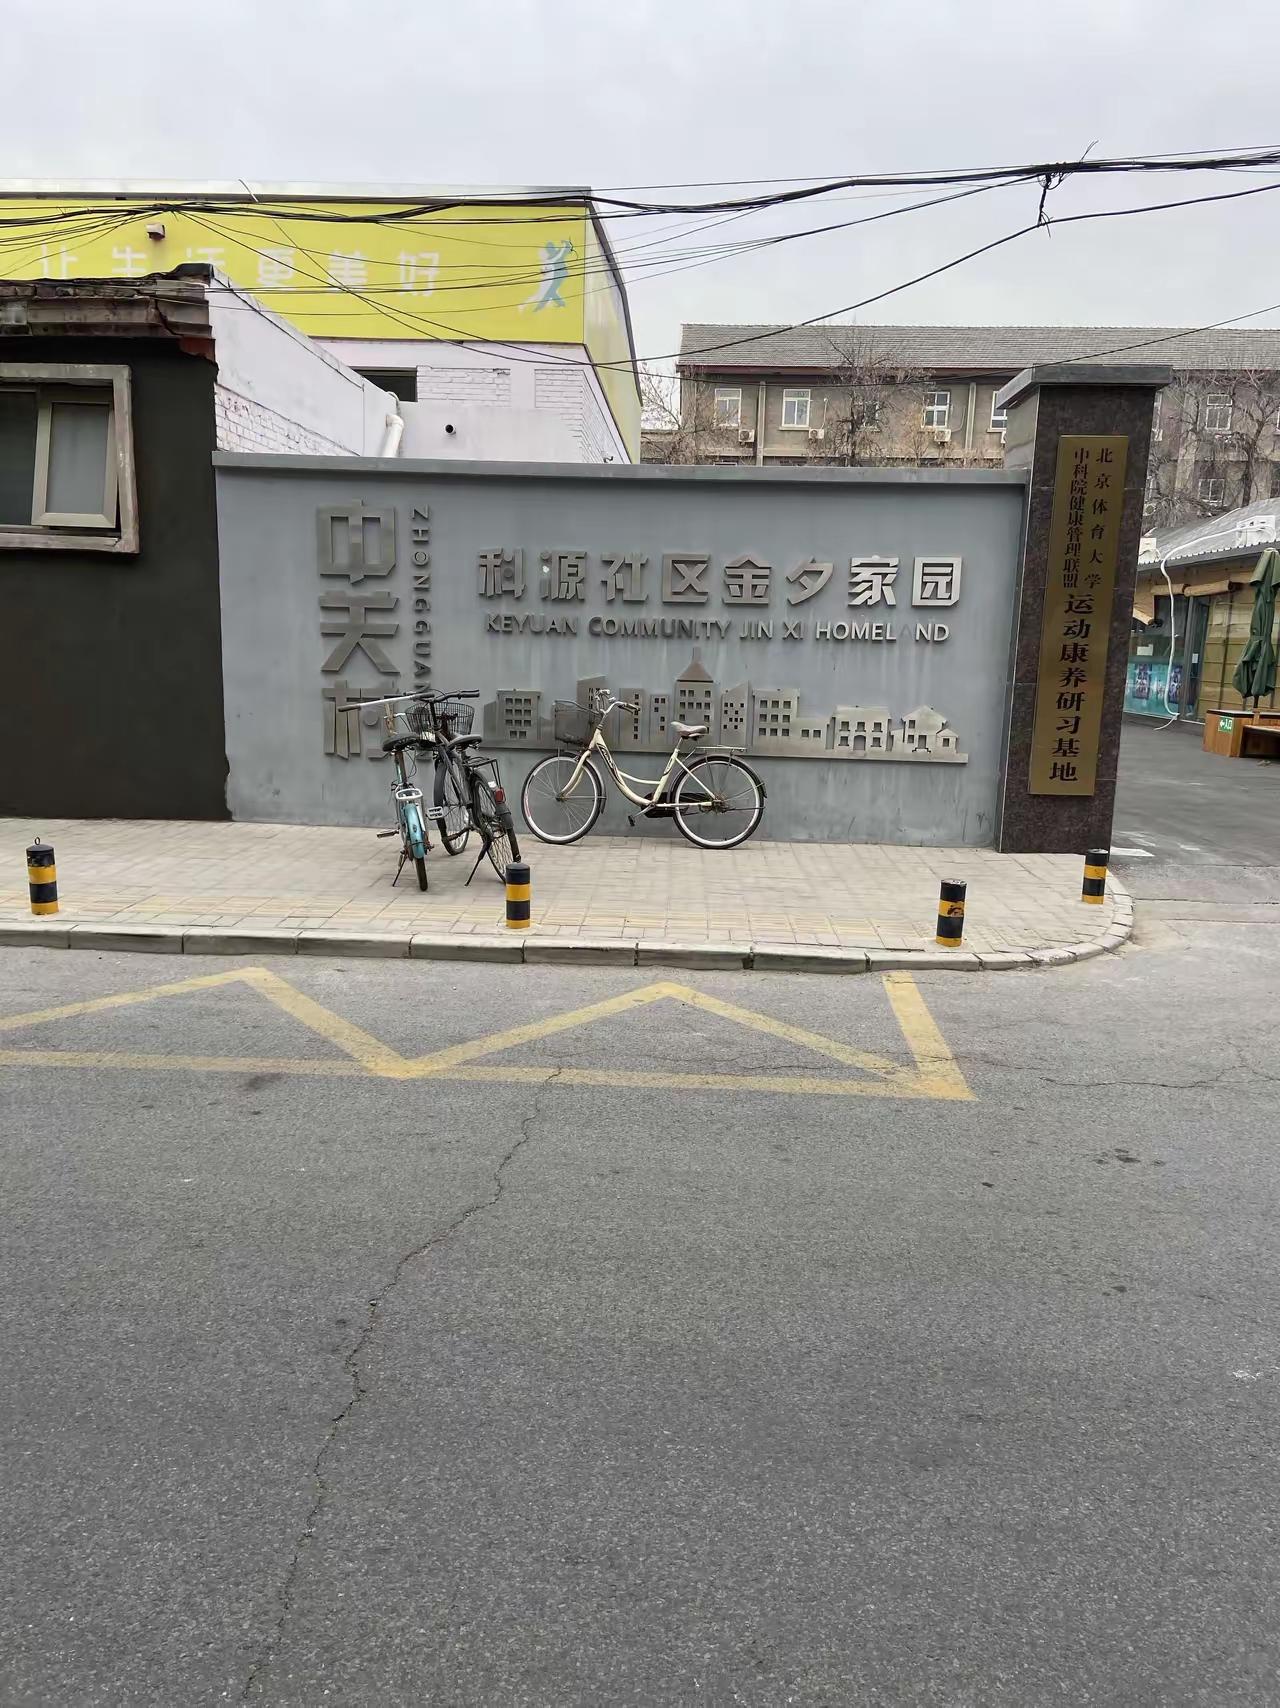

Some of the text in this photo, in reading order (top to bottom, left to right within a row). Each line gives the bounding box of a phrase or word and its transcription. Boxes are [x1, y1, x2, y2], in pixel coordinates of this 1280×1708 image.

[478, 547, 963, 607] 科源社区金夕家园
[1062, 447, 1091, 589] 中科院健康管理联盟
[1083, 447, 1113, 590] 北京体育大学
[316, 499, 400, 761] 中关村
[487, 614, 577, 635] KEYUAN
[588, 616, 731, 640] COMMUNITY
[740, 620, 774, 640] JIN
[1048, 593, 1095, 783] 运动康养研习基地
